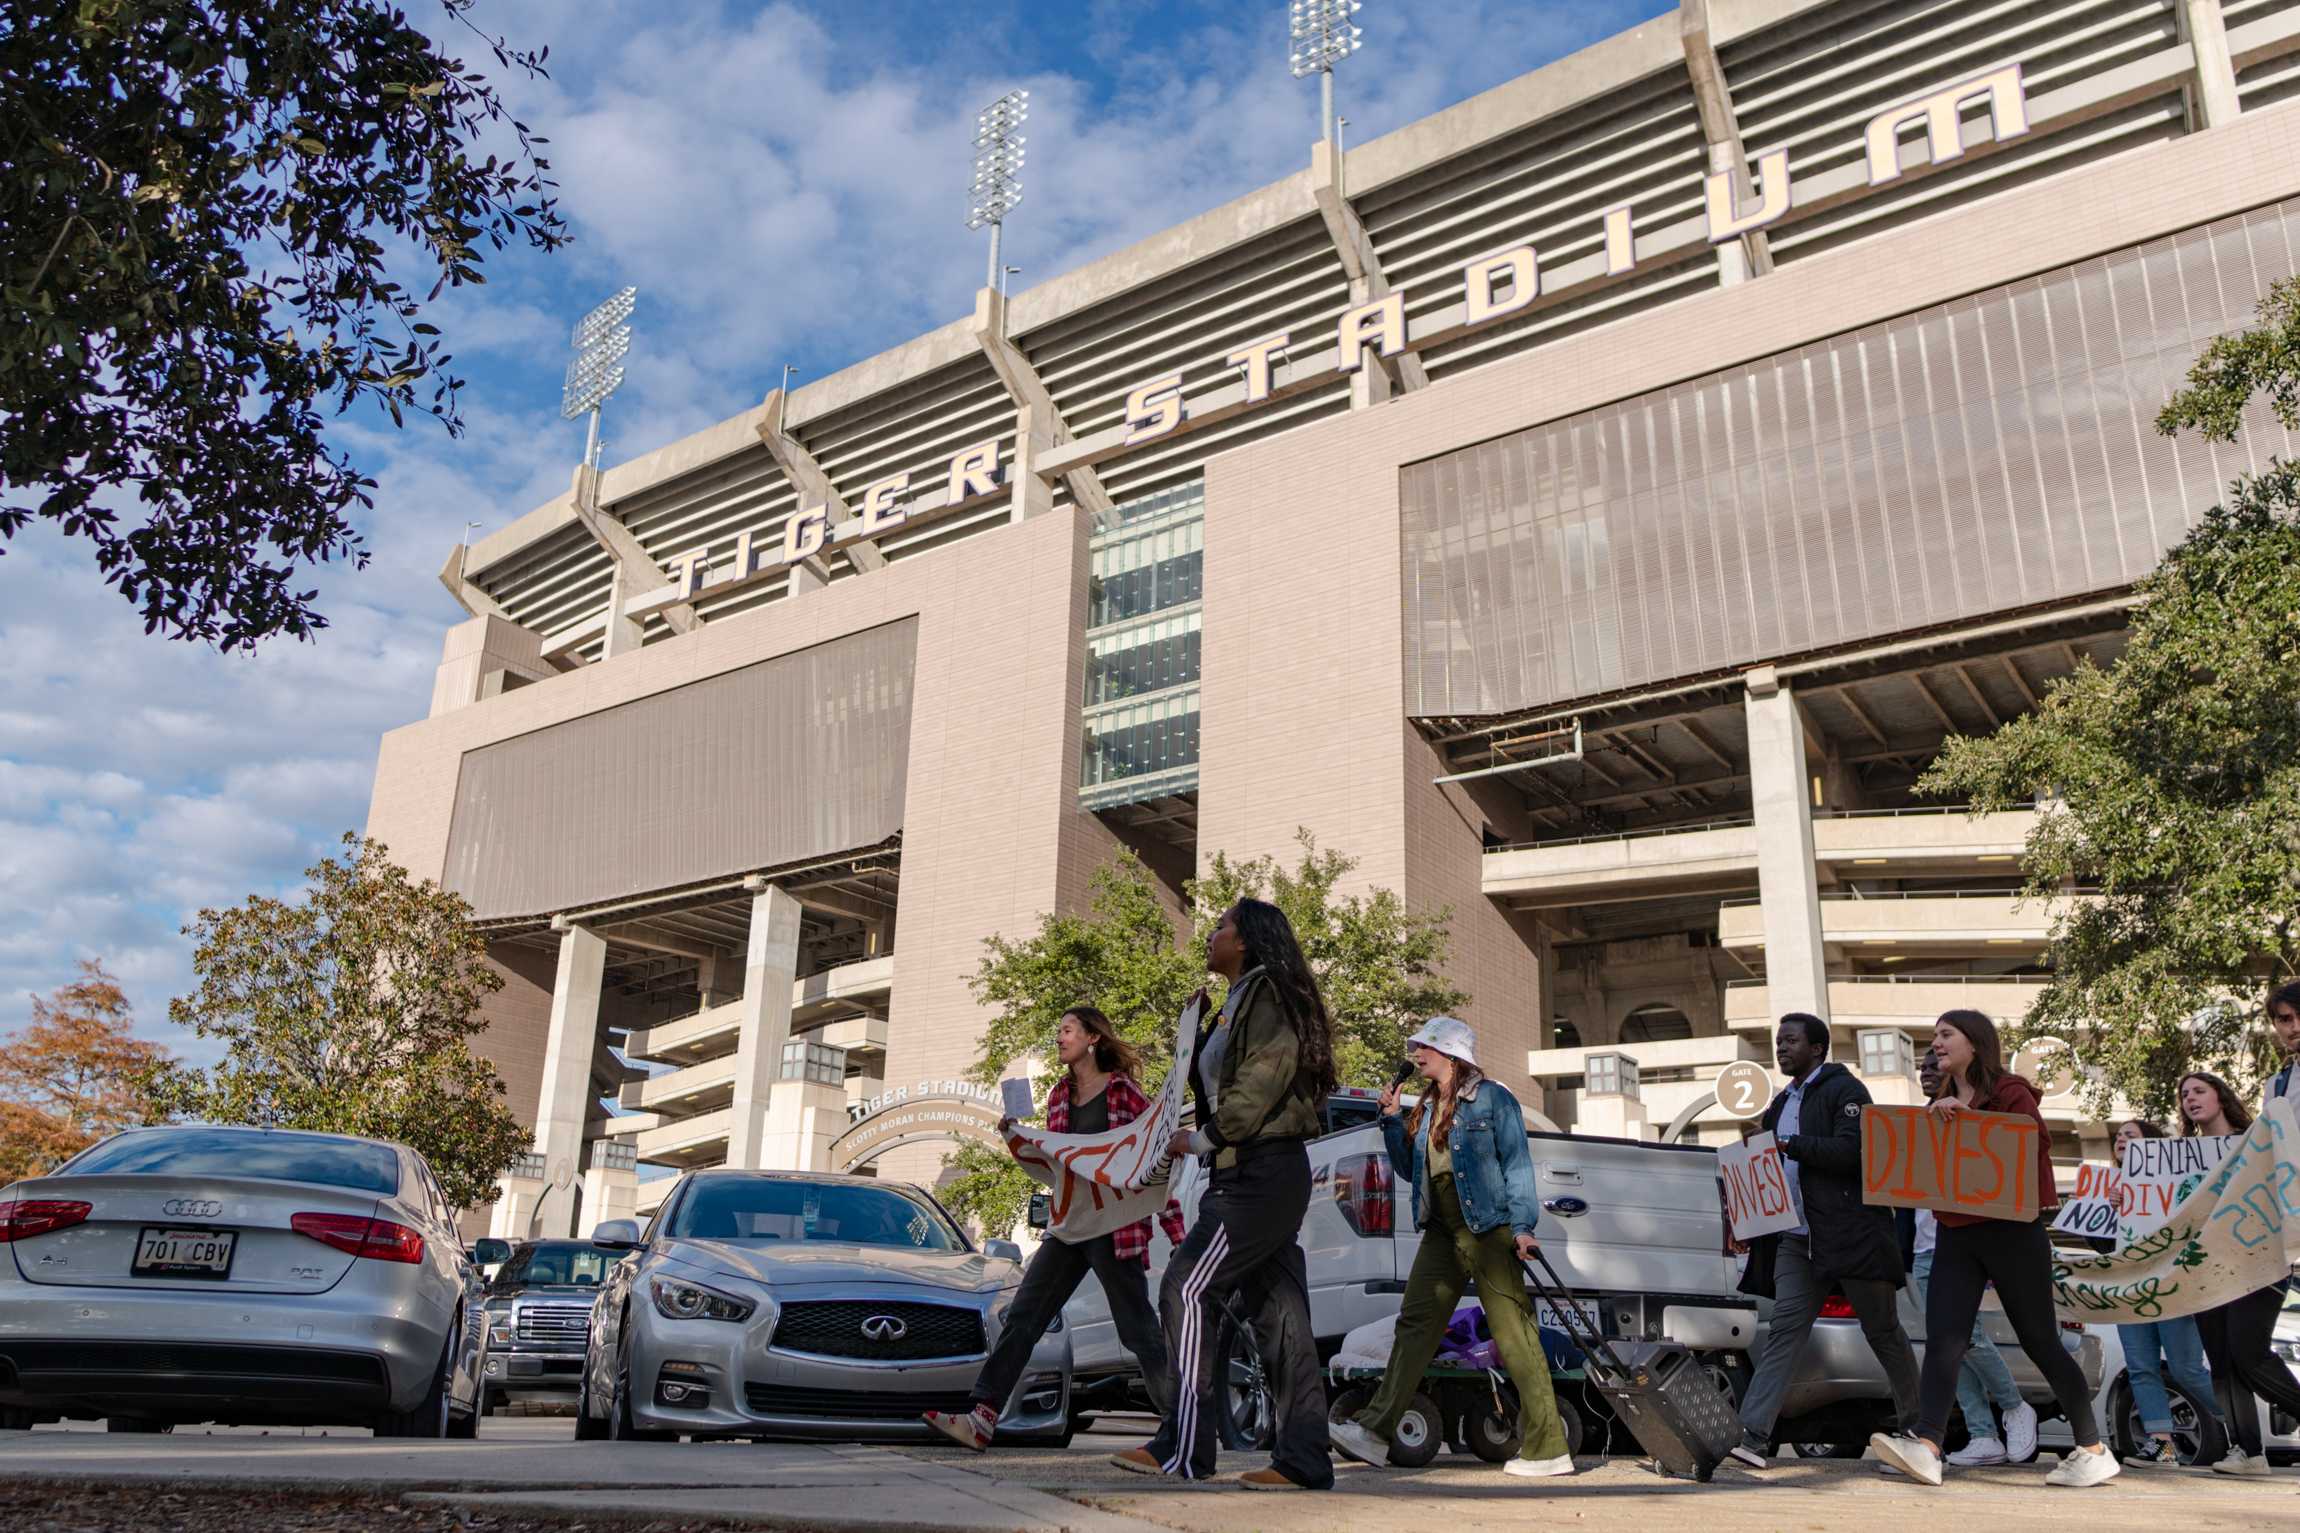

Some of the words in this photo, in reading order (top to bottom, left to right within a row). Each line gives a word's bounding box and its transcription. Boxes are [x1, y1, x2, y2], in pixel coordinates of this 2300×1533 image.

[670, 440, 1001, 601] TIGER
[1123, 62, 2031, 446] STADIUM
[1731, 1068, 1753, 1077] GATE
[851, 1085, 909, 1122] TIGER
[1733, 1080, 1755, 1109] 2
[846, 1125, 879, 1152] SCOTTY
[880, 1113, 914, 1132] MORAN
[917, 1111, 976, 1127] CHAMPIONS
[1866, 1107, 2039, 1214] DIVEST
[2129, 1137, 2209, 1178] DENIAL
[1721, 1147, 1791, 1227] DIVEST
[145, 1240, 178, 1260] 701
